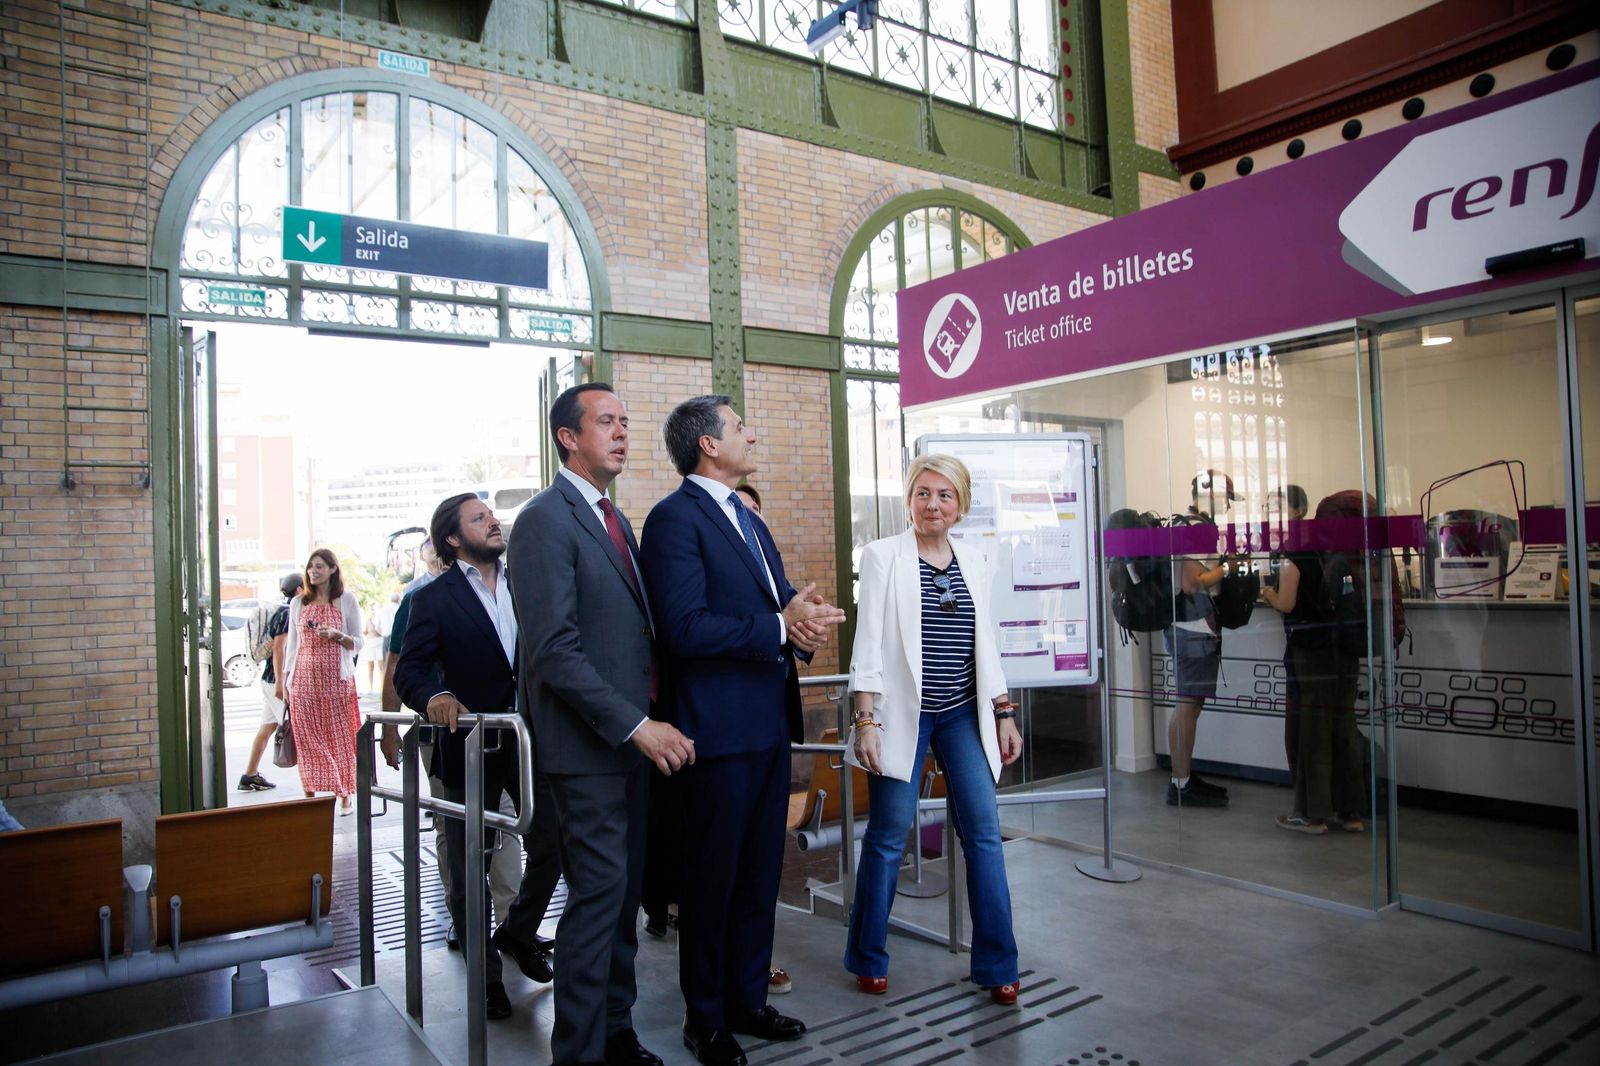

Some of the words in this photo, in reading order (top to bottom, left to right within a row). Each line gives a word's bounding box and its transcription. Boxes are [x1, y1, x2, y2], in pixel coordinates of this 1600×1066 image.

[383, 54, 425, 73] SALIDA
[356, 226, 409, 249] Salida
[355, 248, 380, 261] EXIT
[1003, 283, 1061, 316] Venta
[1068, 271, 1095, 300] de
[1102, 248, 1194, 291] billetes
[211, 290, 264, 304] SALIDA
[530, 318, 571, 331] SALIDA
[1005, 323, 1046, 350] Ticket
[1050, 314, 1092, 340] office
